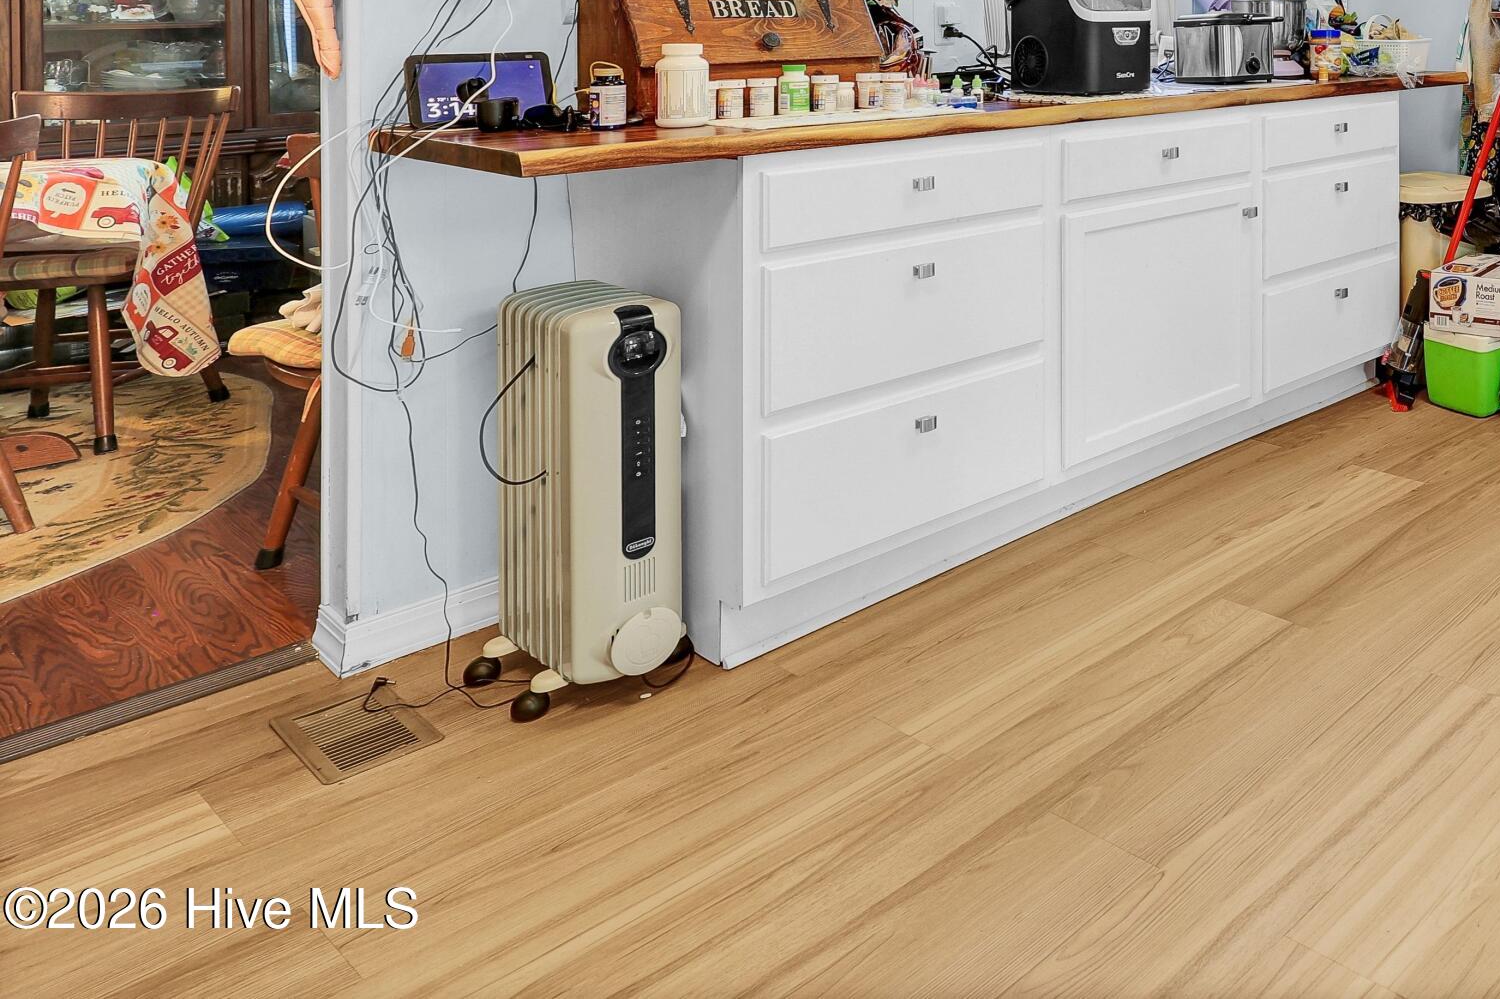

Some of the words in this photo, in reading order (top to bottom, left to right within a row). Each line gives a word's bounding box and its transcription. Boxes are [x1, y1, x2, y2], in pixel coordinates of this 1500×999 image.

[708, 0, 797, 18] BREAD
[1475, 292, 1496, 301] Roast
[154, 306, 181, 324] HELLO
[180, 323, 210, 351] AUTUMN
